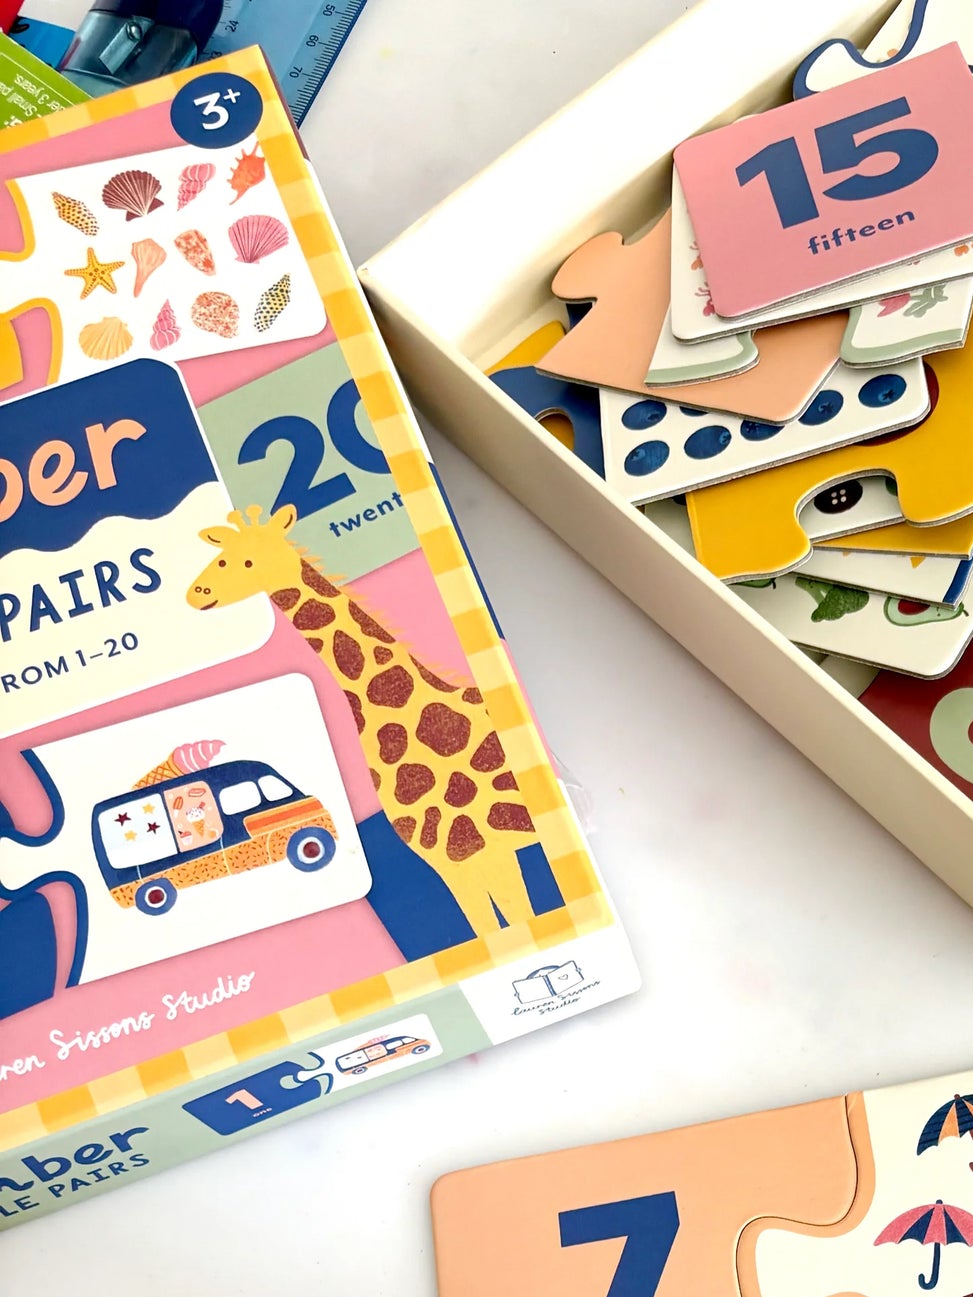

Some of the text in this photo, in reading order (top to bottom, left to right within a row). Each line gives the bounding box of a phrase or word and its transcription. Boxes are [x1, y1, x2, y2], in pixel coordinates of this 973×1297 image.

[225, 20, 239, 33] 24
[323, 4, 336, 17] 50
[306, 34, 319, 47] 60
[289, 66, 303, 79] 70
[193, 88, 241, 130] 3+
[735, 96, 939, 230] 15
[807, 209, 916, 255] fifteen
[0, 548, 161, 643] PAIRS
[50, 1011, 155, 1060] Sissons
[162, 971, 256, 1020] Studio
[225, 1088, 264, 1111] 1
[48, 1153, 150, 1198] PAIRS
